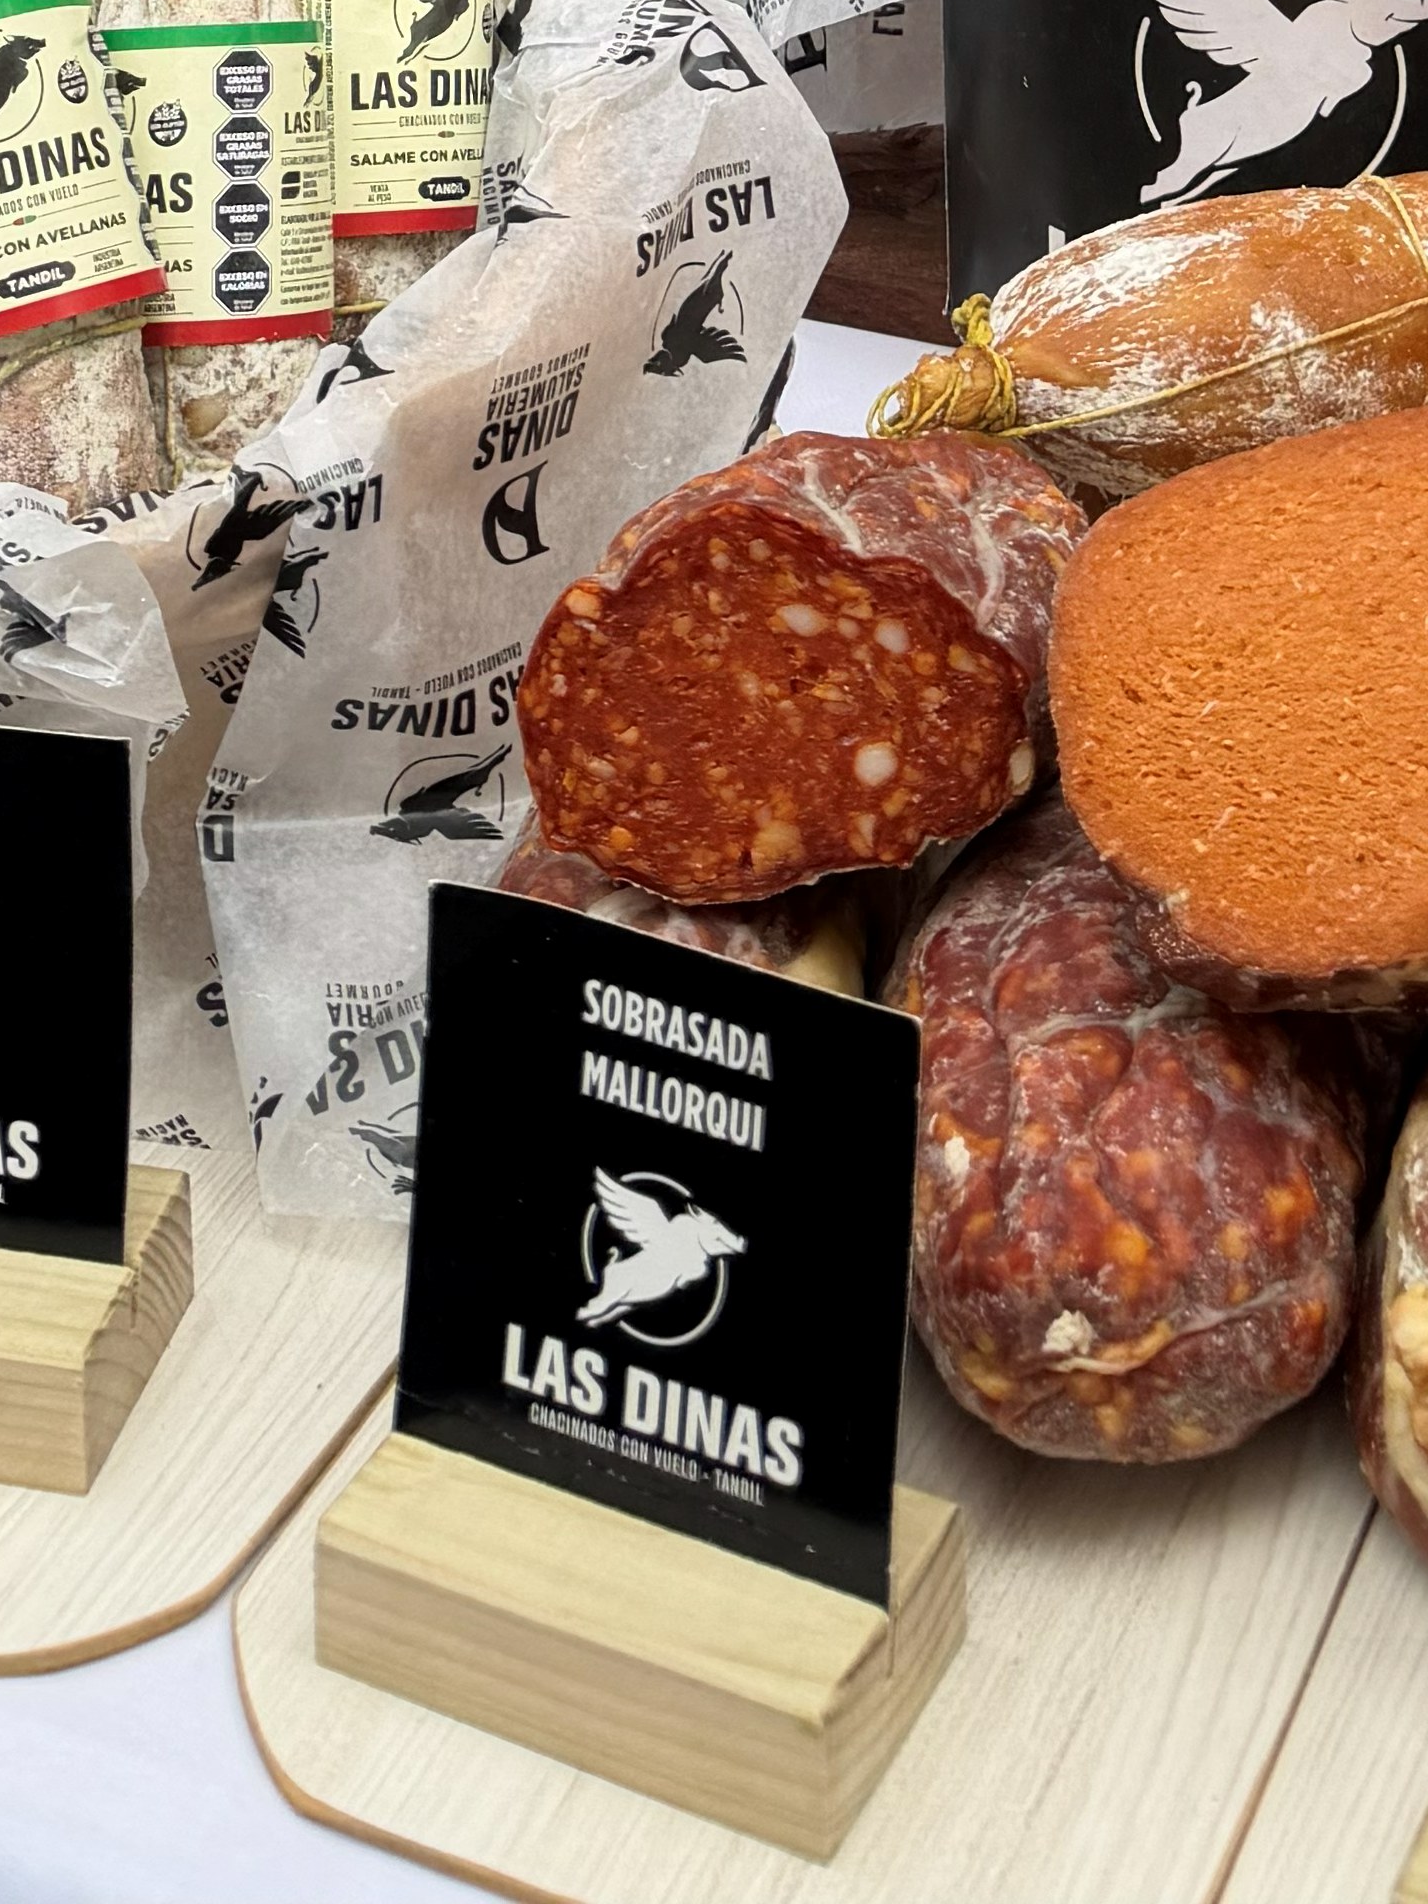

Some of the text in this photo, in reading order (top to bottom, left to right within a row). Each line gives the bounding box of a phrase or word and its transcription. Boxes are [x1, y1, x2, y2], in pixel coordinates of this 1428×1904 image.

[224, 84, 264, 94] TOTALES
[350, 70, 417, 111] LAS
[350, 149, 447, 167] SALAME CON
[27, 192, 46, 209] CON
[49, 183, 79, 203] VUELO
[229, 213, 258, 224] SODIO
[705, 175, 776, 233] LAS
[36, 212, 126, 249] AVELLANAS
[6, 268, 66, 293] TANDIL
[486, 362, 585, 422] SALUMERIA
[473, 388, 579, 472] DINAS
[313, 474, 382, 531] LAS
[331, 688, 476, 738] DINAS
[582, 978, 773, 1082] SOBRASADA
[581, 1050, 766, 1153] MALLORQUI
[501, 1323, 804, 1488] LAS DINAS
[528, 1402, 700, 1483] CHACINADOS CON VUELO
